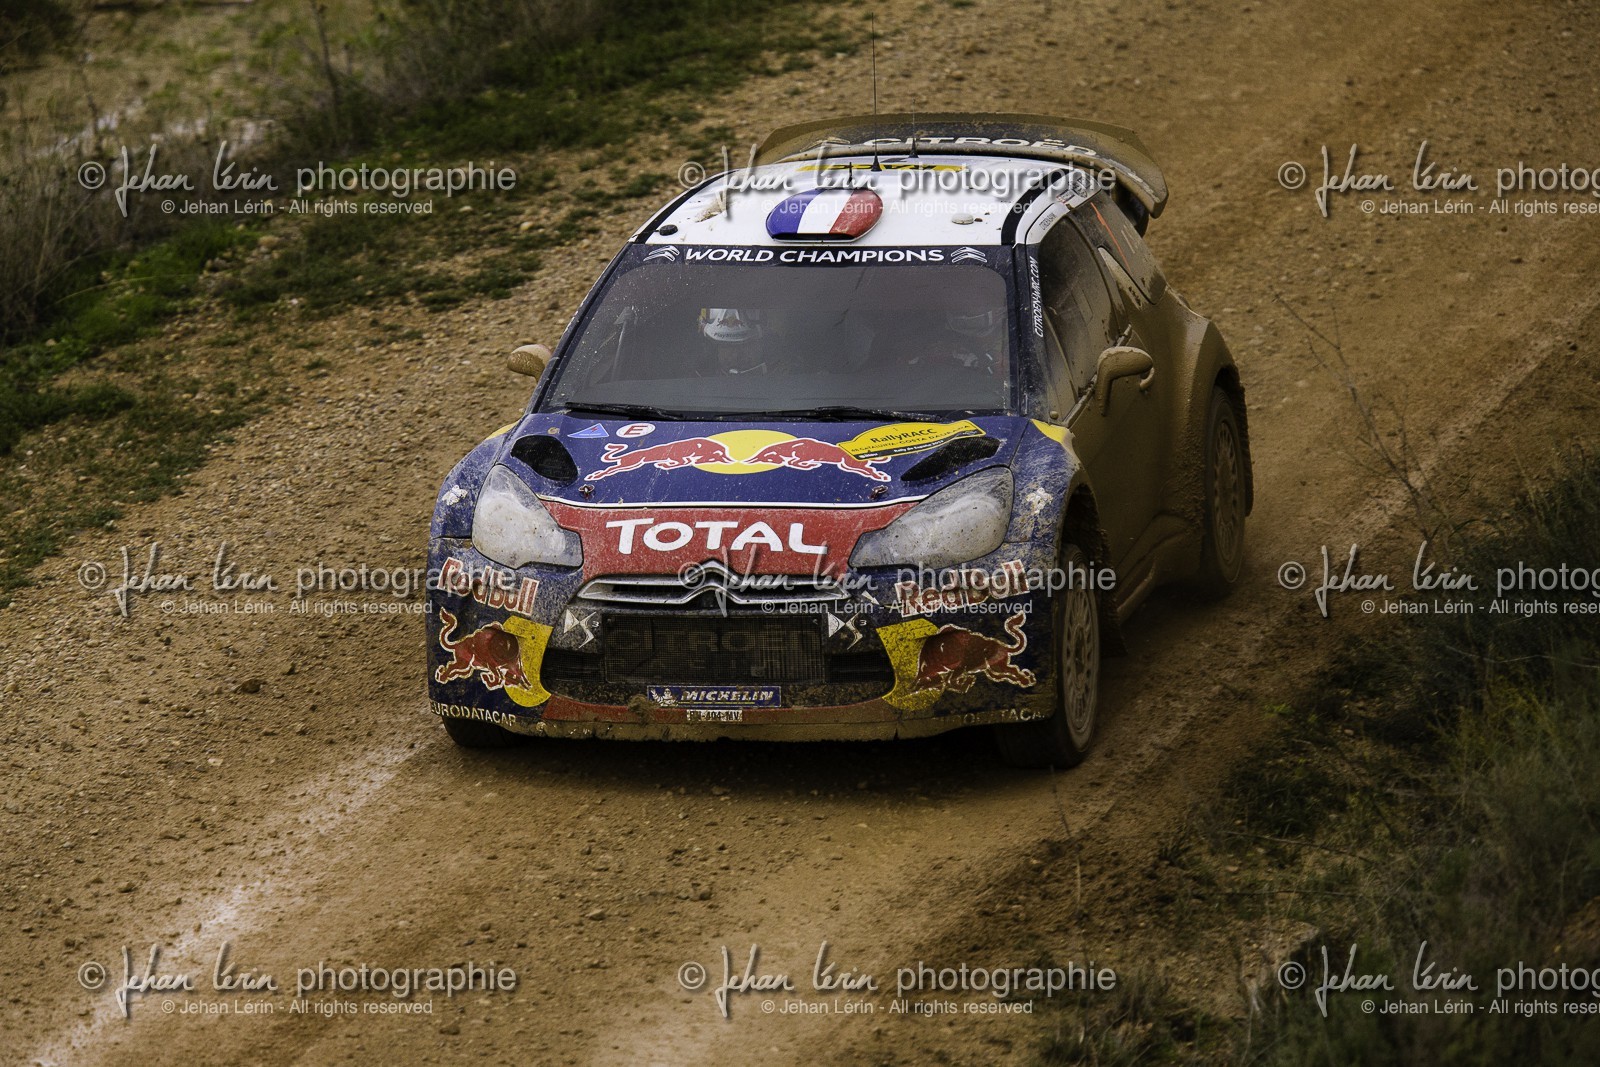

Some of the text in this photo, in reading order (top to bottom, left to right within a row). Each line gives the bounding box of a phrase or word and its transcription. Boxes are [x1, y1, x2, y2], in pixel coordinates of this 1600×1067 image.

[685, 248, 944, 263] WORLD CHAMPIONS
[624, 425, 648, 436] E
[605, 518, 828, 555] TOTAL
[680, 690, 774, 701] MICHELIN
